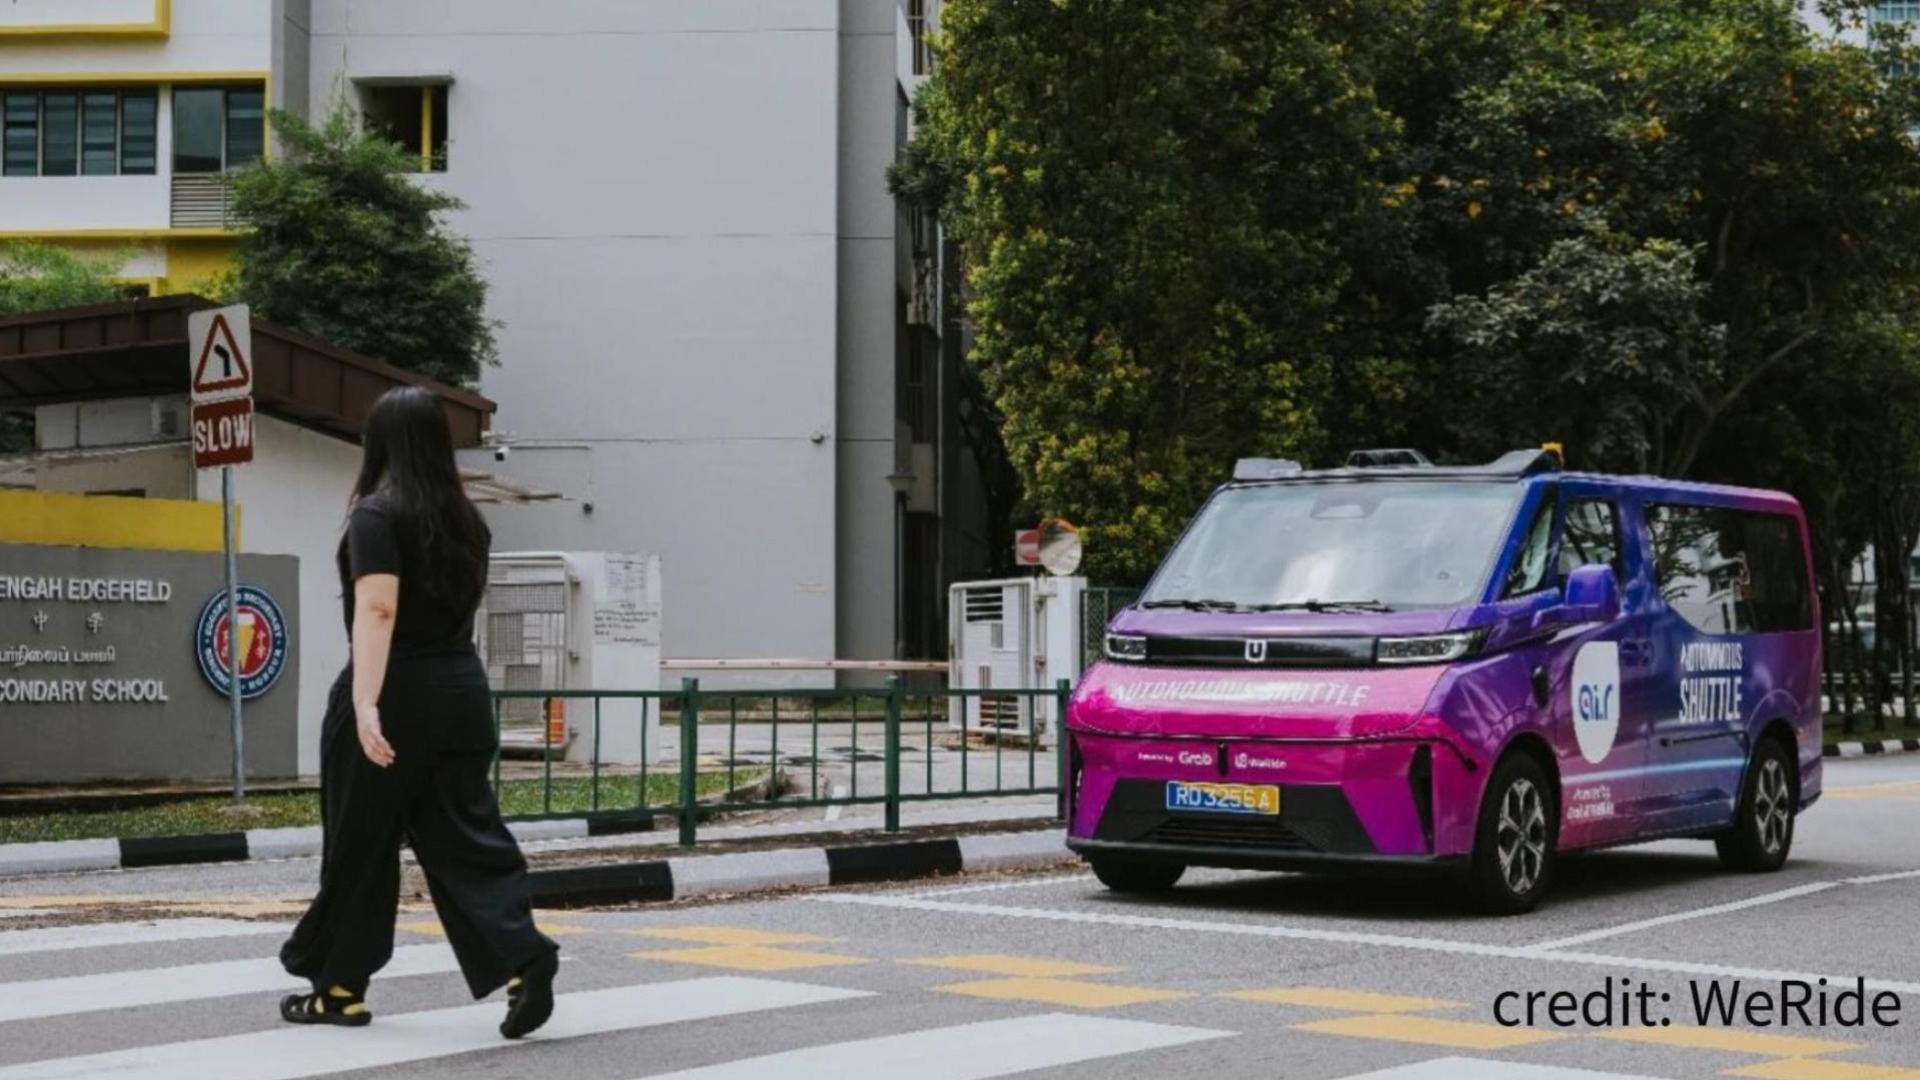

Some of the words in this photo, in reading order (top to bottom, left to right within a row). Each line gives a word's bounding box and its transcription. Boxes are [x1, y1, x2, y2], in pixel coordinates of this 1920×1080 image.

[195, 413, 251, 454] SLOW
[68, 578, 172, 602] EDGEFIELD
[1680, 642, 1743, 672] AUTONOMOUS
[91, 678, 168, 702] SCHOOL
[1110, 680, 1254, 702] AUTONOMOUS
[1257, 681, 1371, 707] SHUTTLE
[1679, 676, 1743, 723] SHUTTLE
[1178, 751, 1213, 766] Grab
